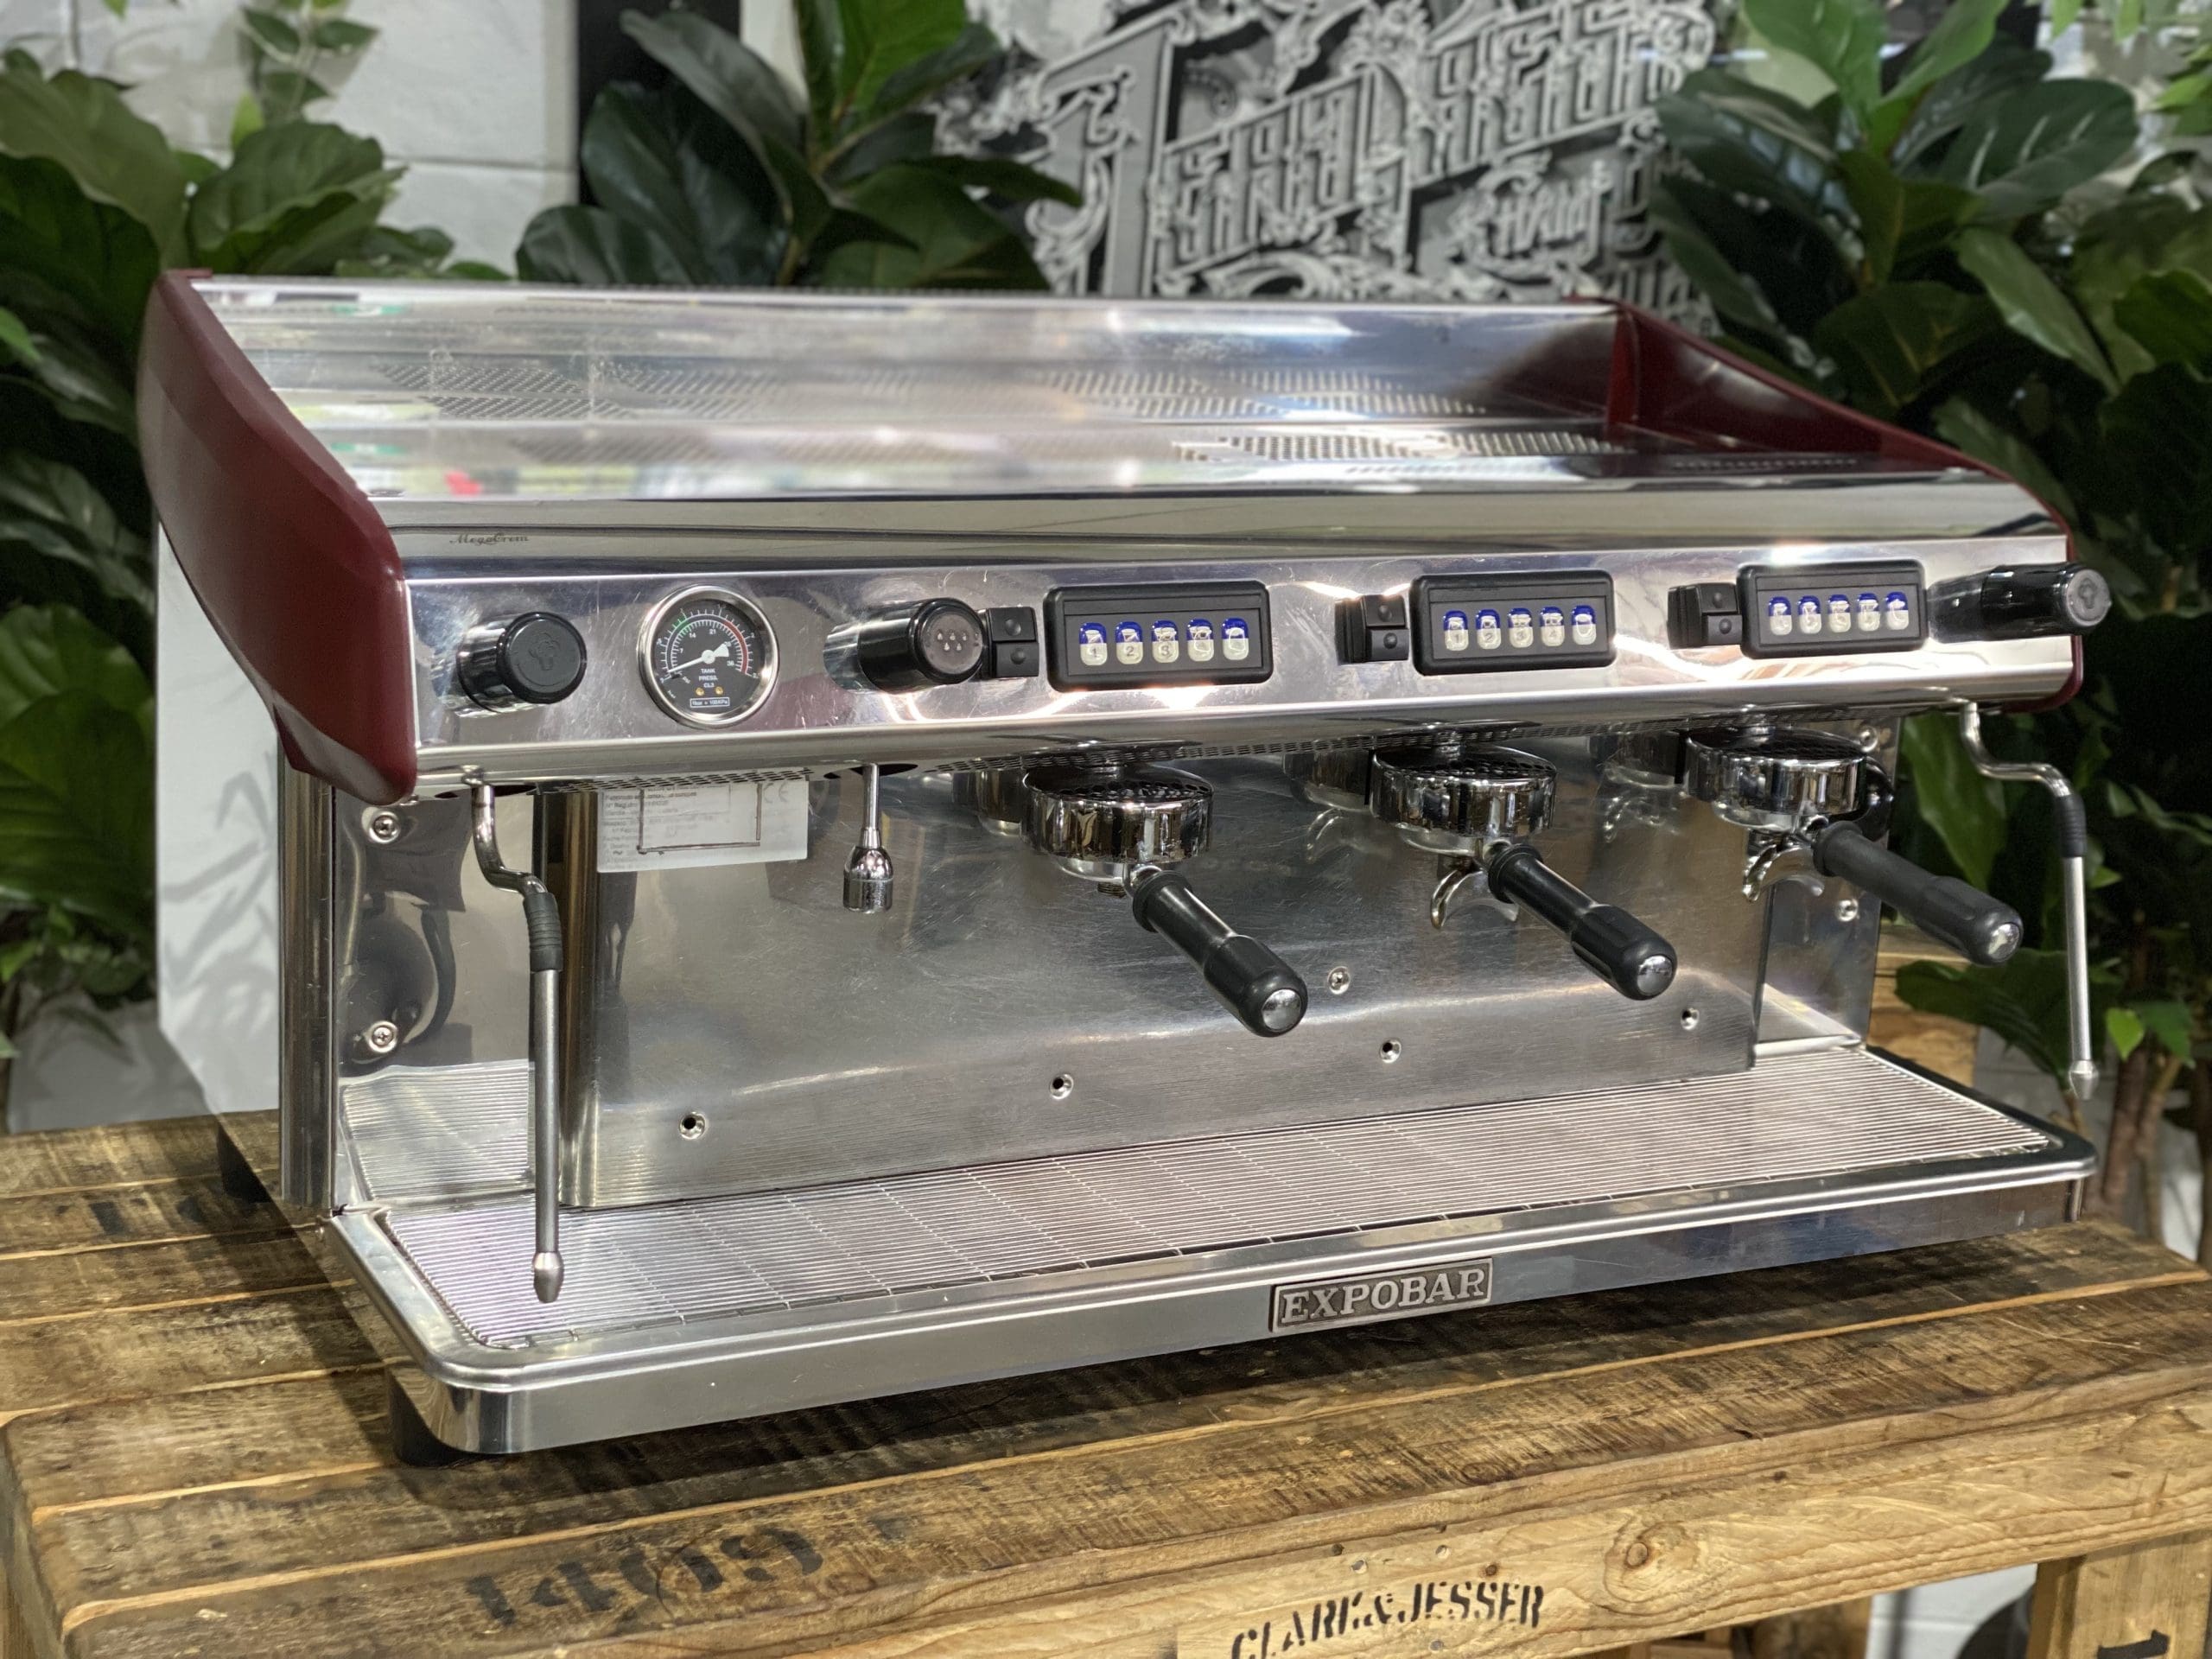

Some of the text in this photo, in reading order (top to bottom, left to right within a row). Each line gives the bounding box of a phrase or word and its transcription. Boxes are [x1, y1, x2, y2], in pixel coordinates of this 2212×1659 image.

[1484, 632, 1494, 643] 2
[1126, 645, 1135, 657] 2
[1281, 1268, 1486, 1324] EXPOBAR
